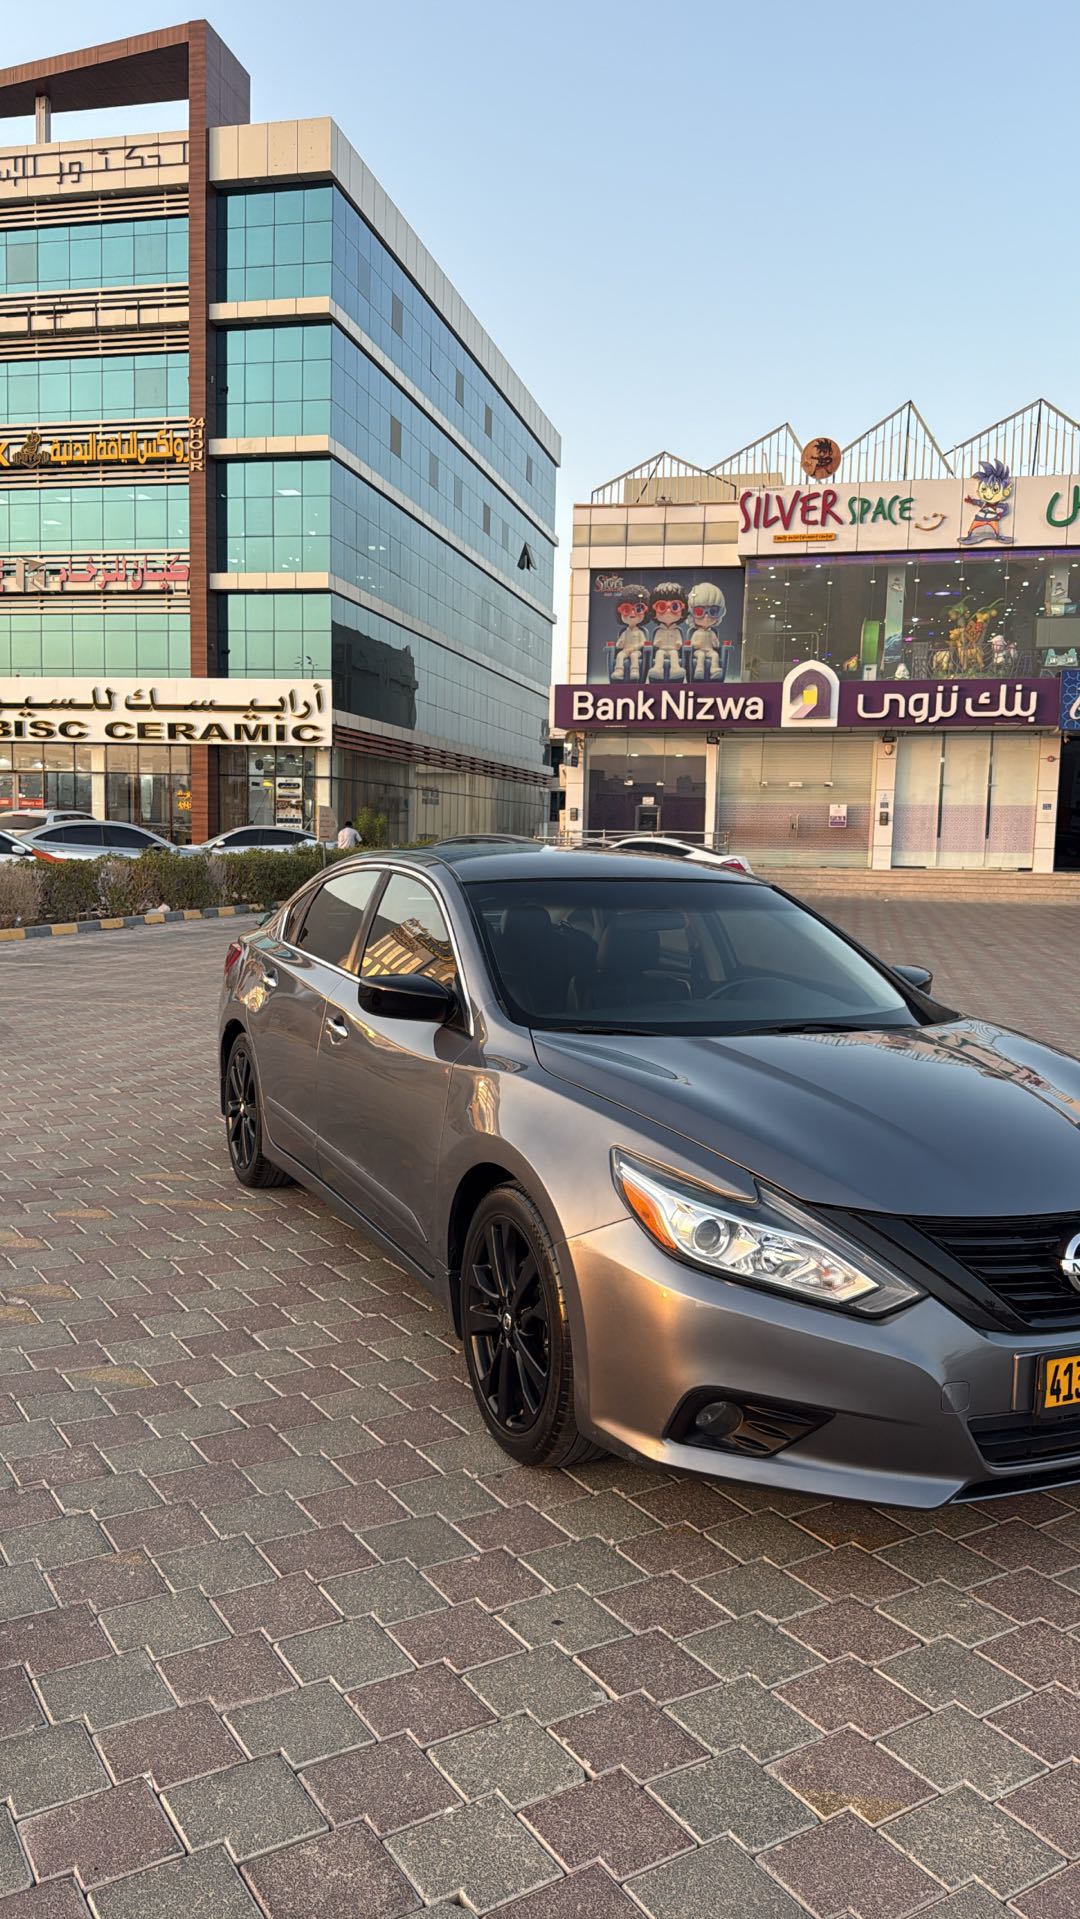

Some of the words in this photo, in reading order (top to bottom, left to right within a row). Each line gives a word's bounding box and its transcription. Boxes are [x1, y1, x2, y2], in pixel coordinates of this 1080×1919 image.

[189, 417, 205, 428] 24
[189, 428, 204, 471] HOUR
[739, 488, 844, 533] SILVER
[848, 494, 915, 525] SPACE
[0, 687, 115, 718] للسي
[124, 682, 324, 721] أرابيسك
[572, 689, 654, 721] Bank
[661, 689, 764, 721] Nizwa
[856, 684, 960, 724] نزوى
[964, 683, 1038, 723] بنك
[104, 721, 324, 742] CERAMIC
